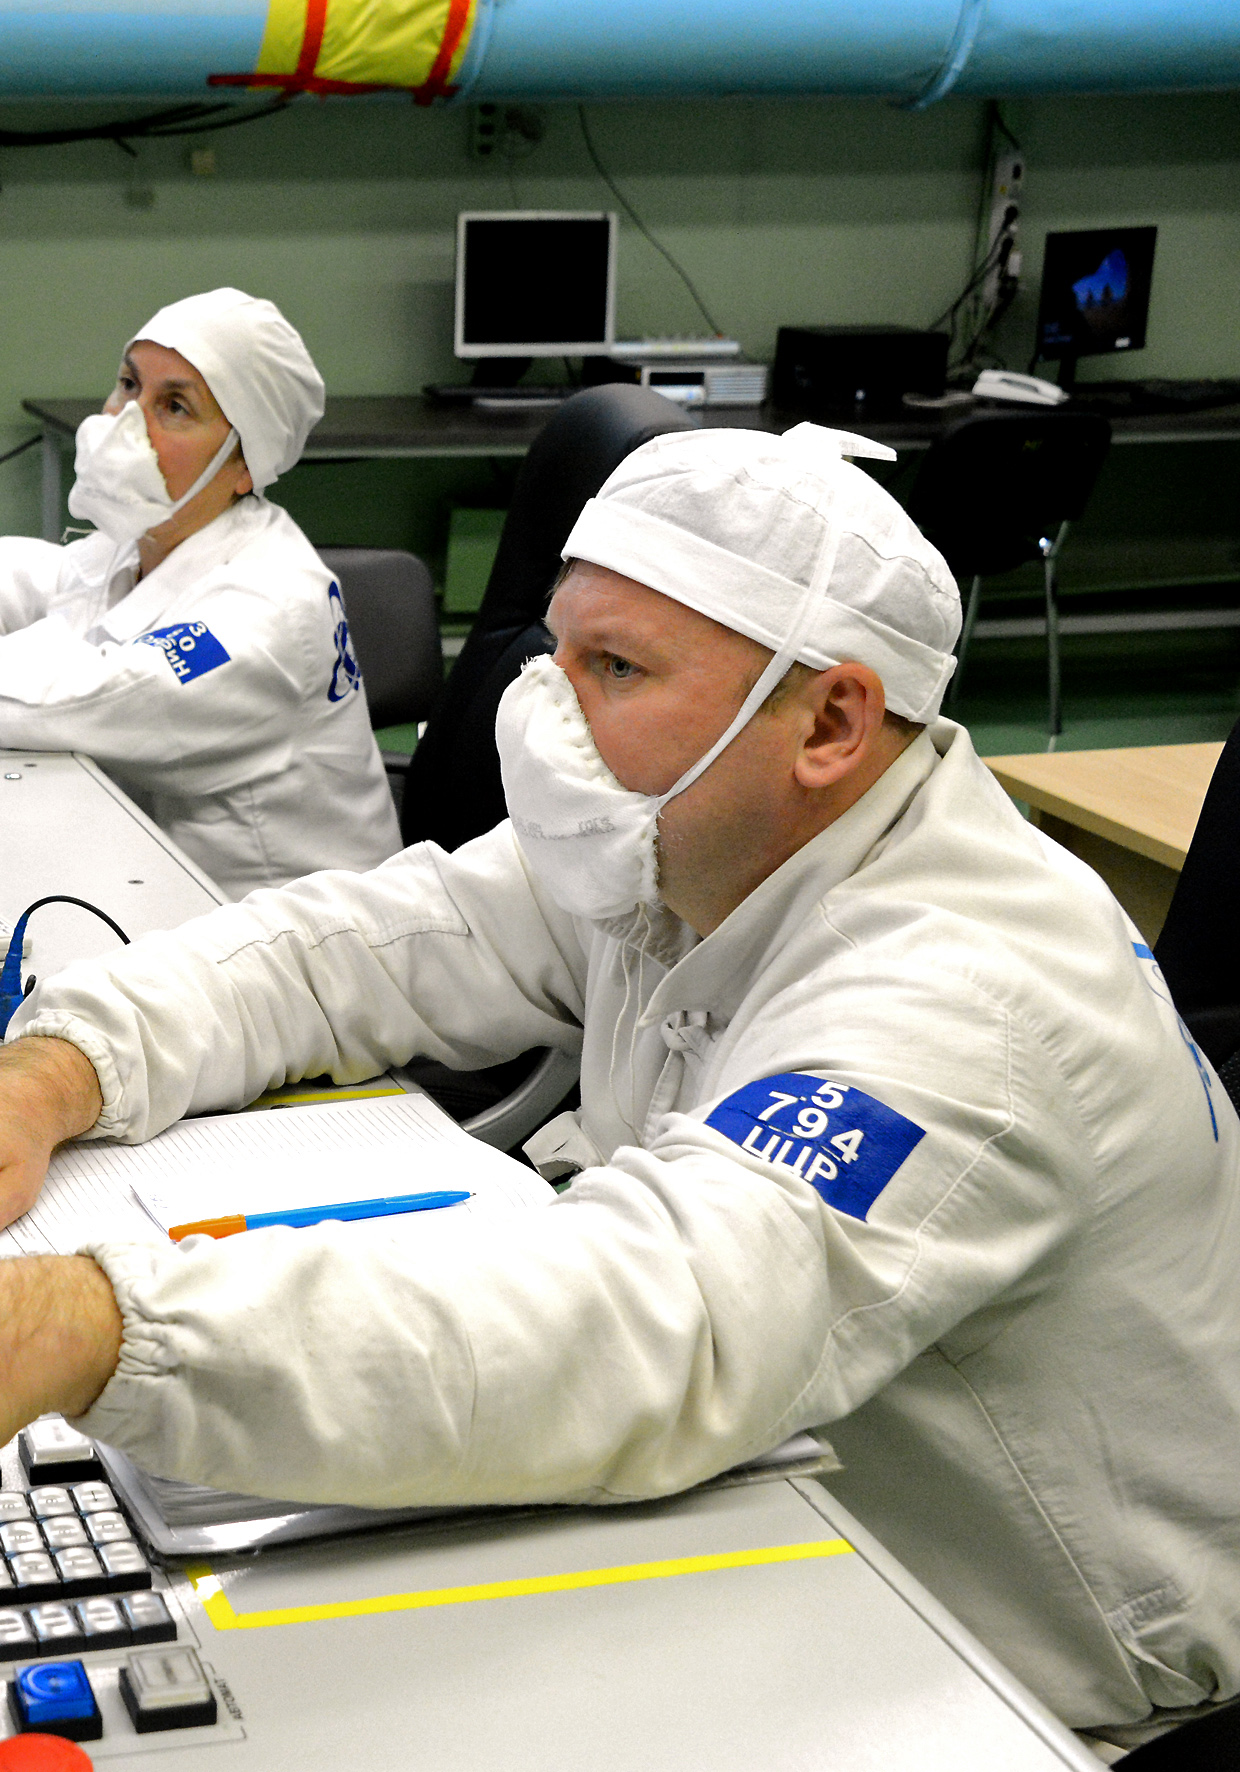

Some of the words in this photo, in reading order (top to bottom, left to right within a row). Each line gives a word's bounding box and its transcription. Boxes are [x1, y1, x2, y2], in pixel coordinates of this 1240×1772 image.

[810, 1081, 850, 1110] 5
[757, 1091, 866, 1164] 794
[213, 1677, 243, 1720] АВТОМАТ
